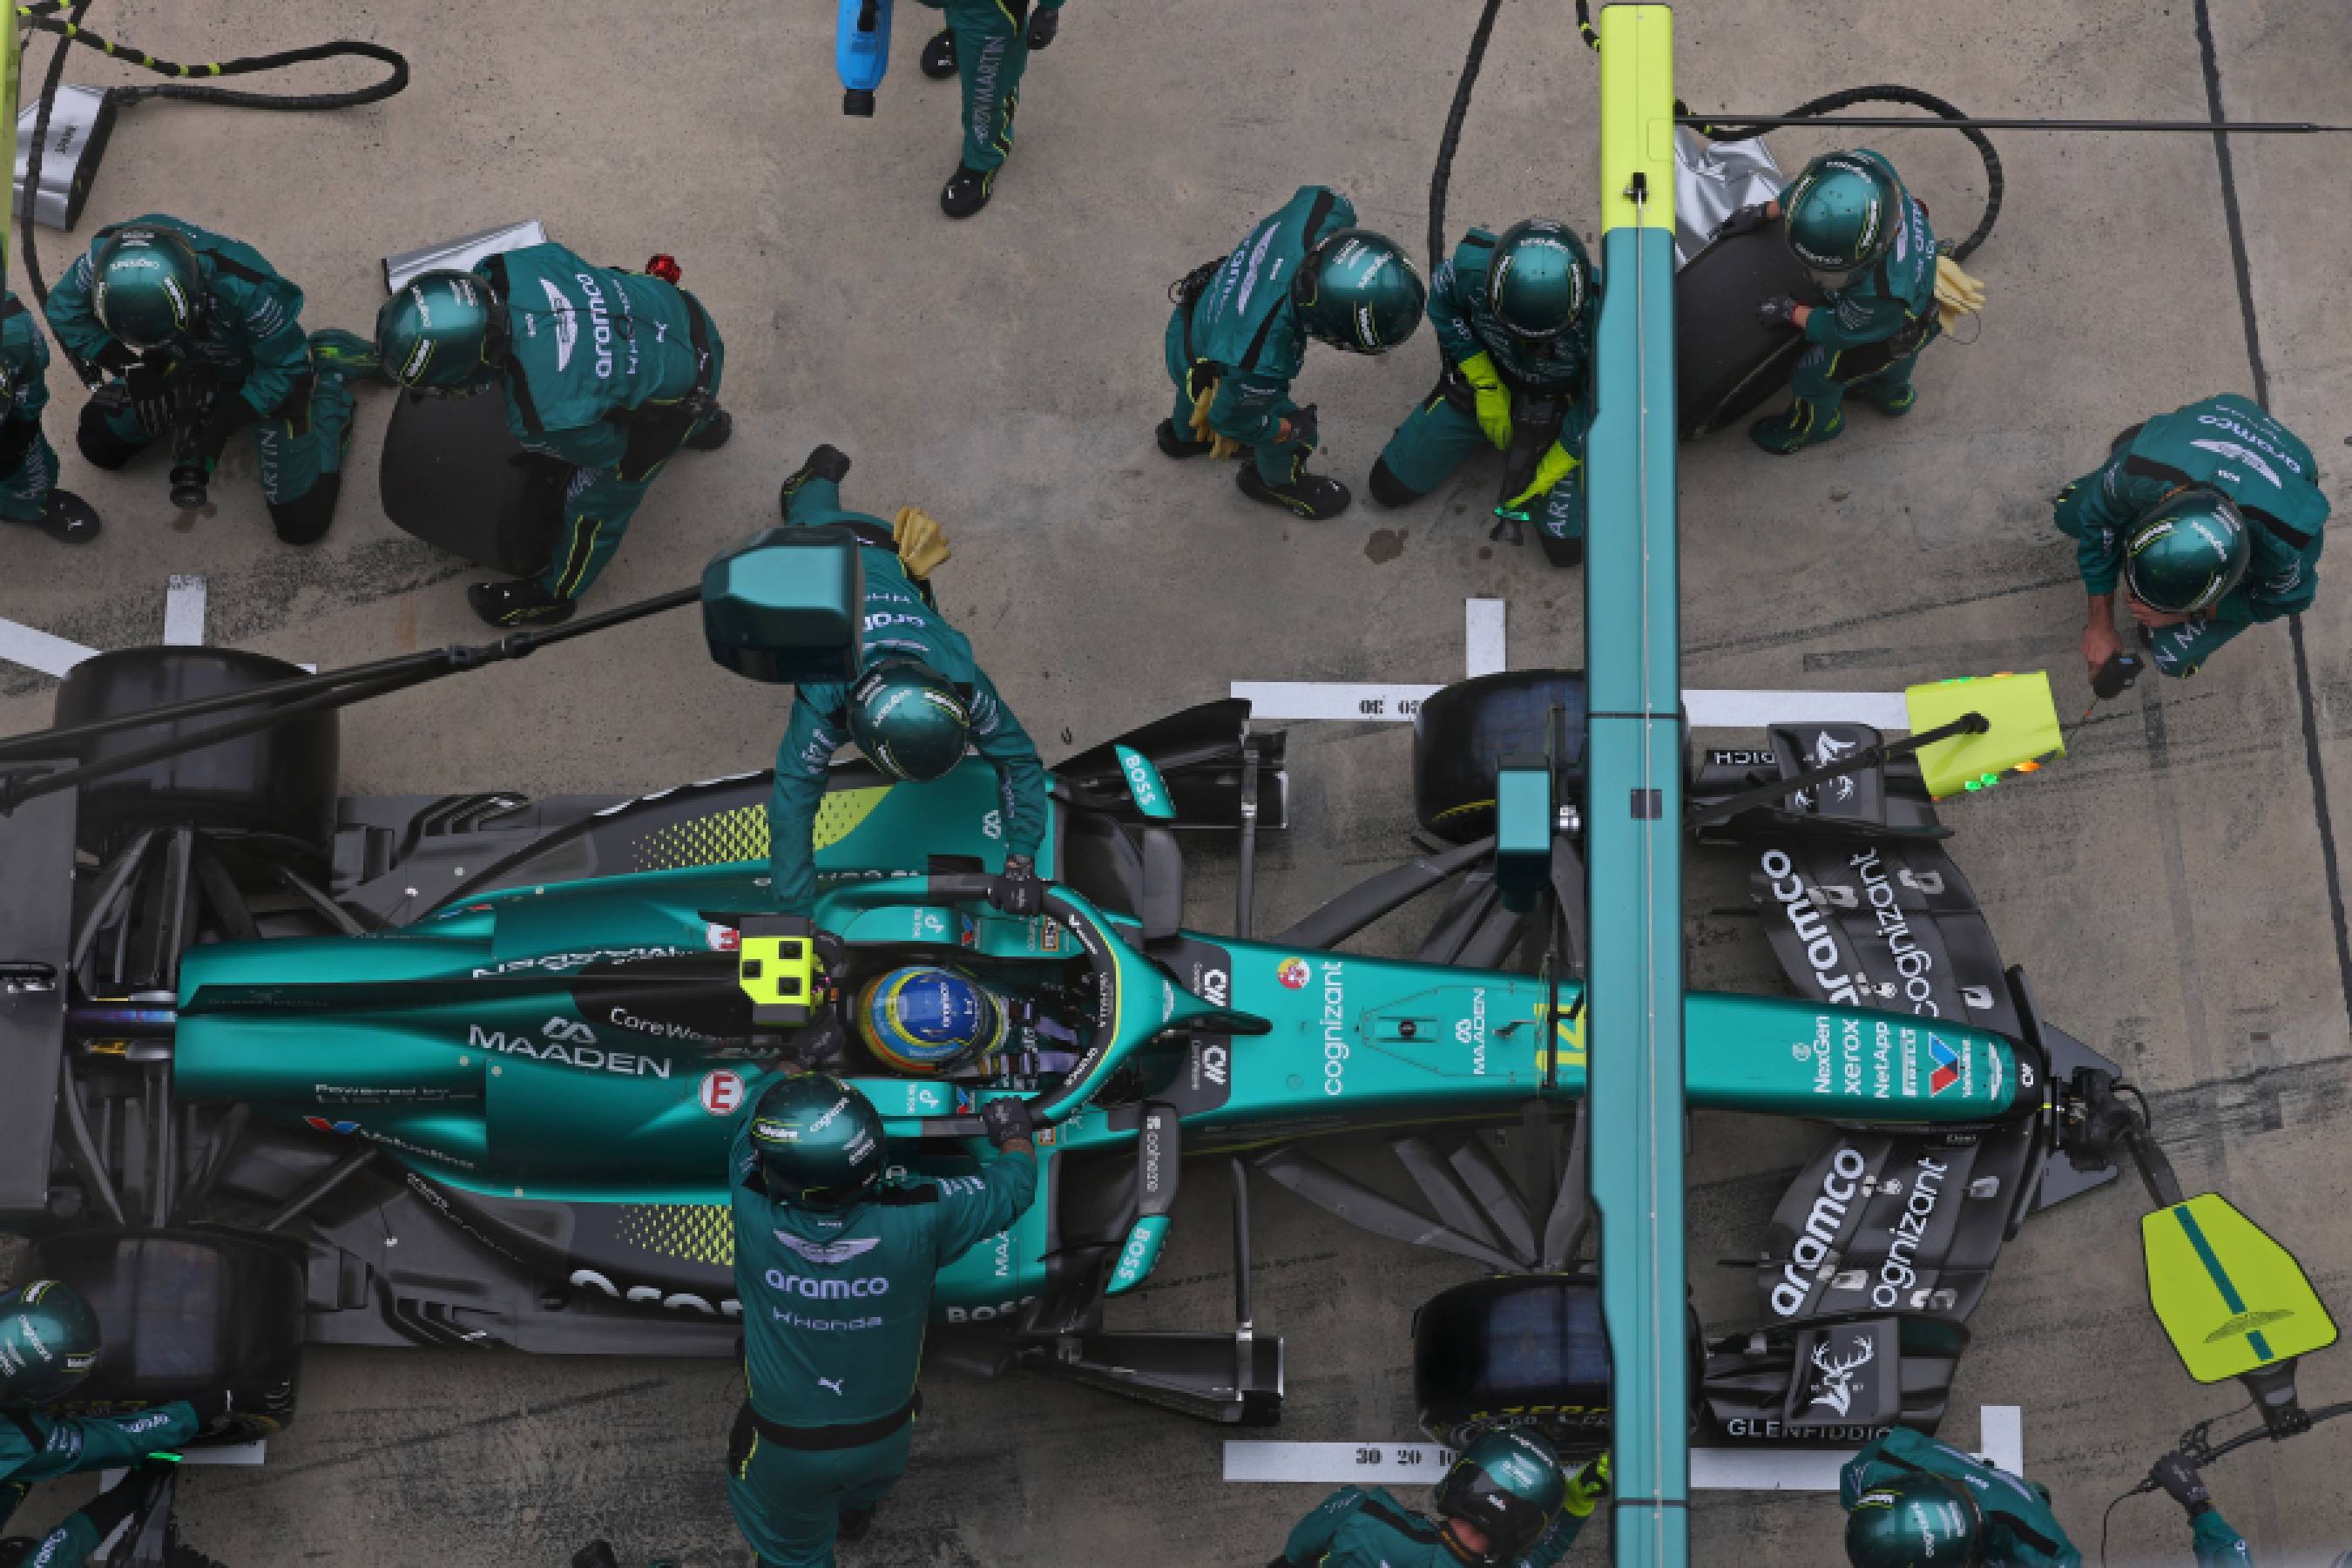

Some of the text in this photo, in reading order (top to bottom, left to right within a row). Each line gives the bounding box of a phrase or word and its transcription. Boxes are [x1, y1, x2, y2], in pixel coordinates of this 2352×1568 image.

[576, 274, 612, 379] aramco
[261, 428, 281, 500] ARTIN
[2198, 415, 2301, 473] aramco
[1125, 754, 1157, 806] BOSS
[468, 1024, 672, 1078] MAADEN
[1319, 961, 1351, 1095] cognizant
[1473, 987, 1485, 1075] MAADEN
[1814, 1015, 1832, 1093] NexGen
[1843, 1019, 1861, 1095] xerox
[1874, 1021, 1891, 1098] NetApp
[710, 1074, 733, 1109] E
[995, 1231, 1009, 1276] MAA
[1119, 1227, 1152, 1281] BOSS
[1771, 1148, 1864, 1316] aramco
[1872, 1157, 1949, 1308] ognizant
[765, 1268, 889, 1300] aramco
[798, 1314, 882, 1330] Honda
[1356, 1448, 1382, 1464] 30
[1397, 1450, 1421, 1465] 20
[1727, 1419, 1892, 1440] GLENFIDDIC
